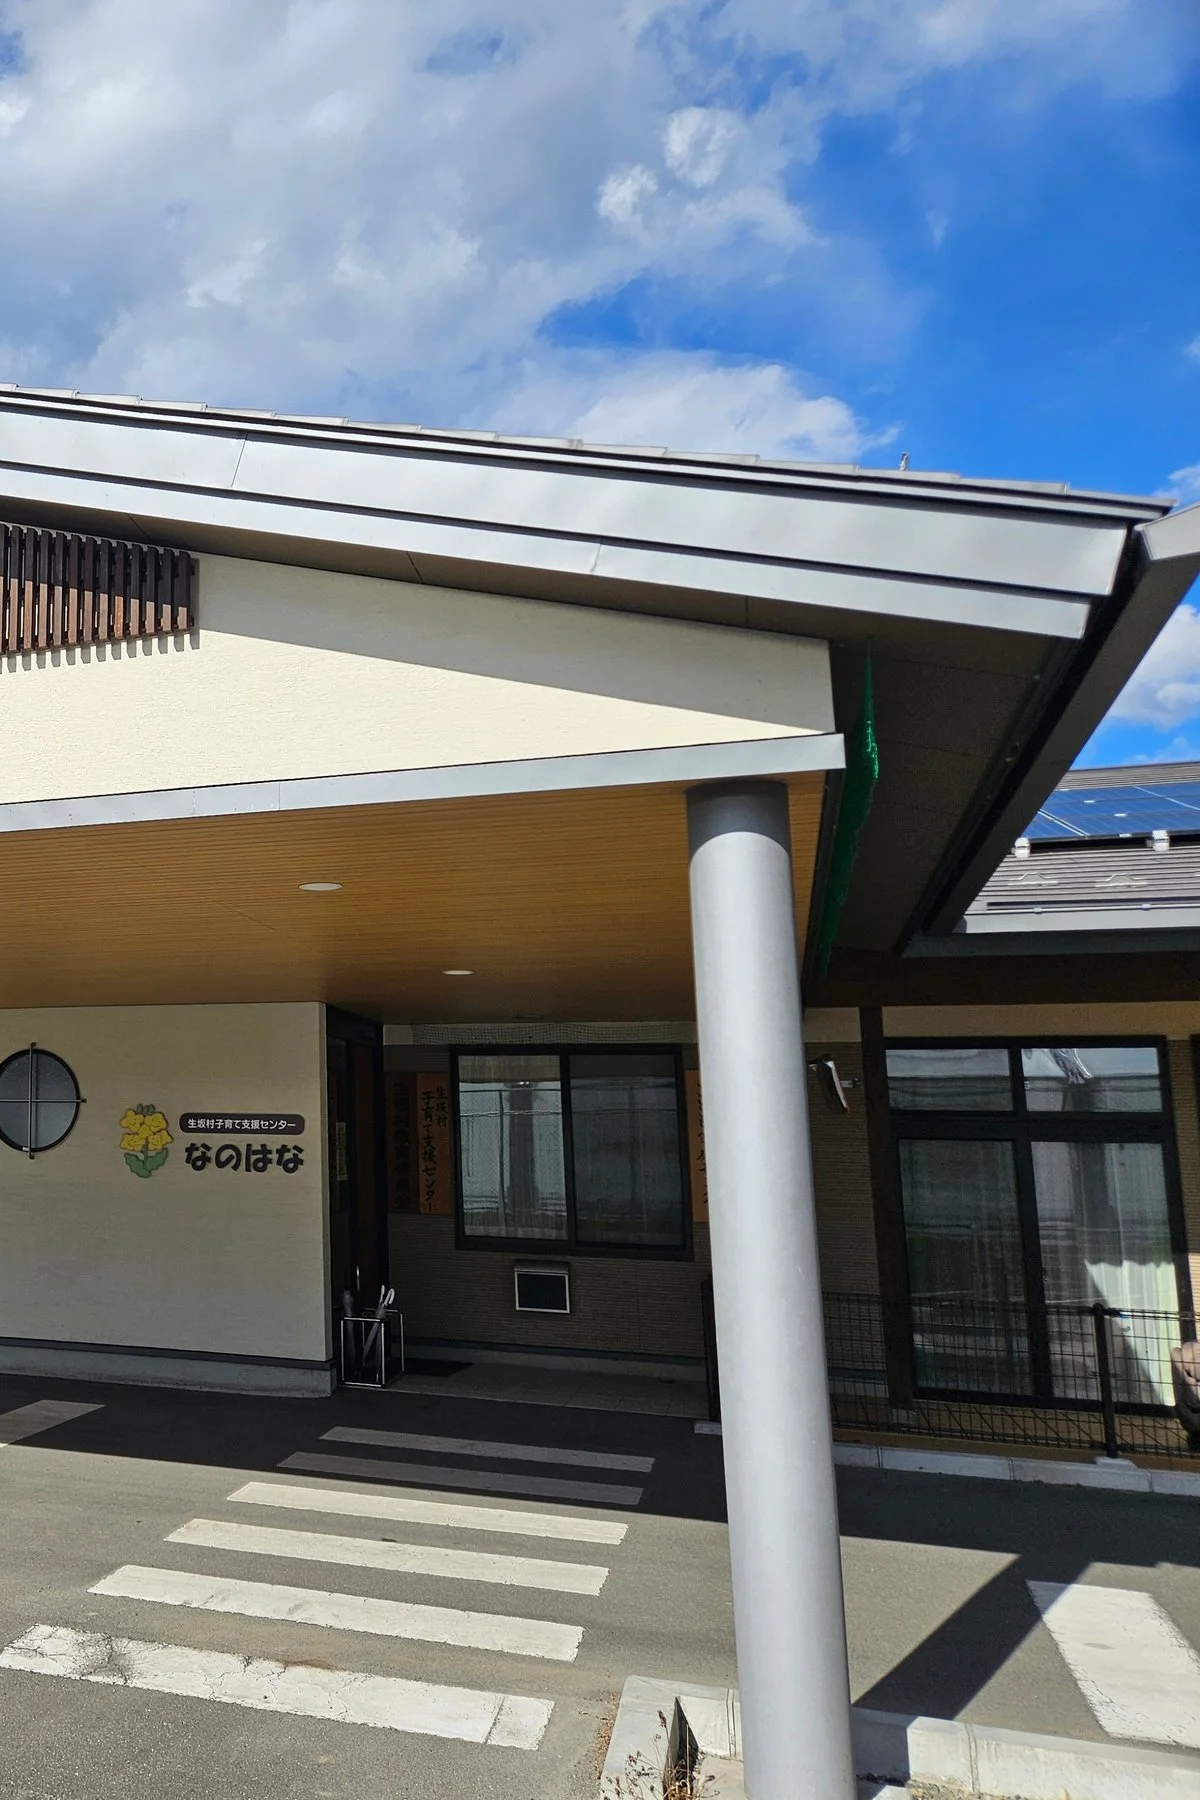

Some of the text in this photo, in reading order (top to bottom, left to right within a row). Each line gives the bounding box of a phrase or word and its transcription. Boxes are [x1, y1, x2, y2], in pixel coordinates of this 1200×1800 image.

[187, 1118, 296, 1131] 生坂村子育て支援センター
[185, 1142, 304, 1174] なのはな
[421, 1091, 437, 1212] 子育て支援センター
